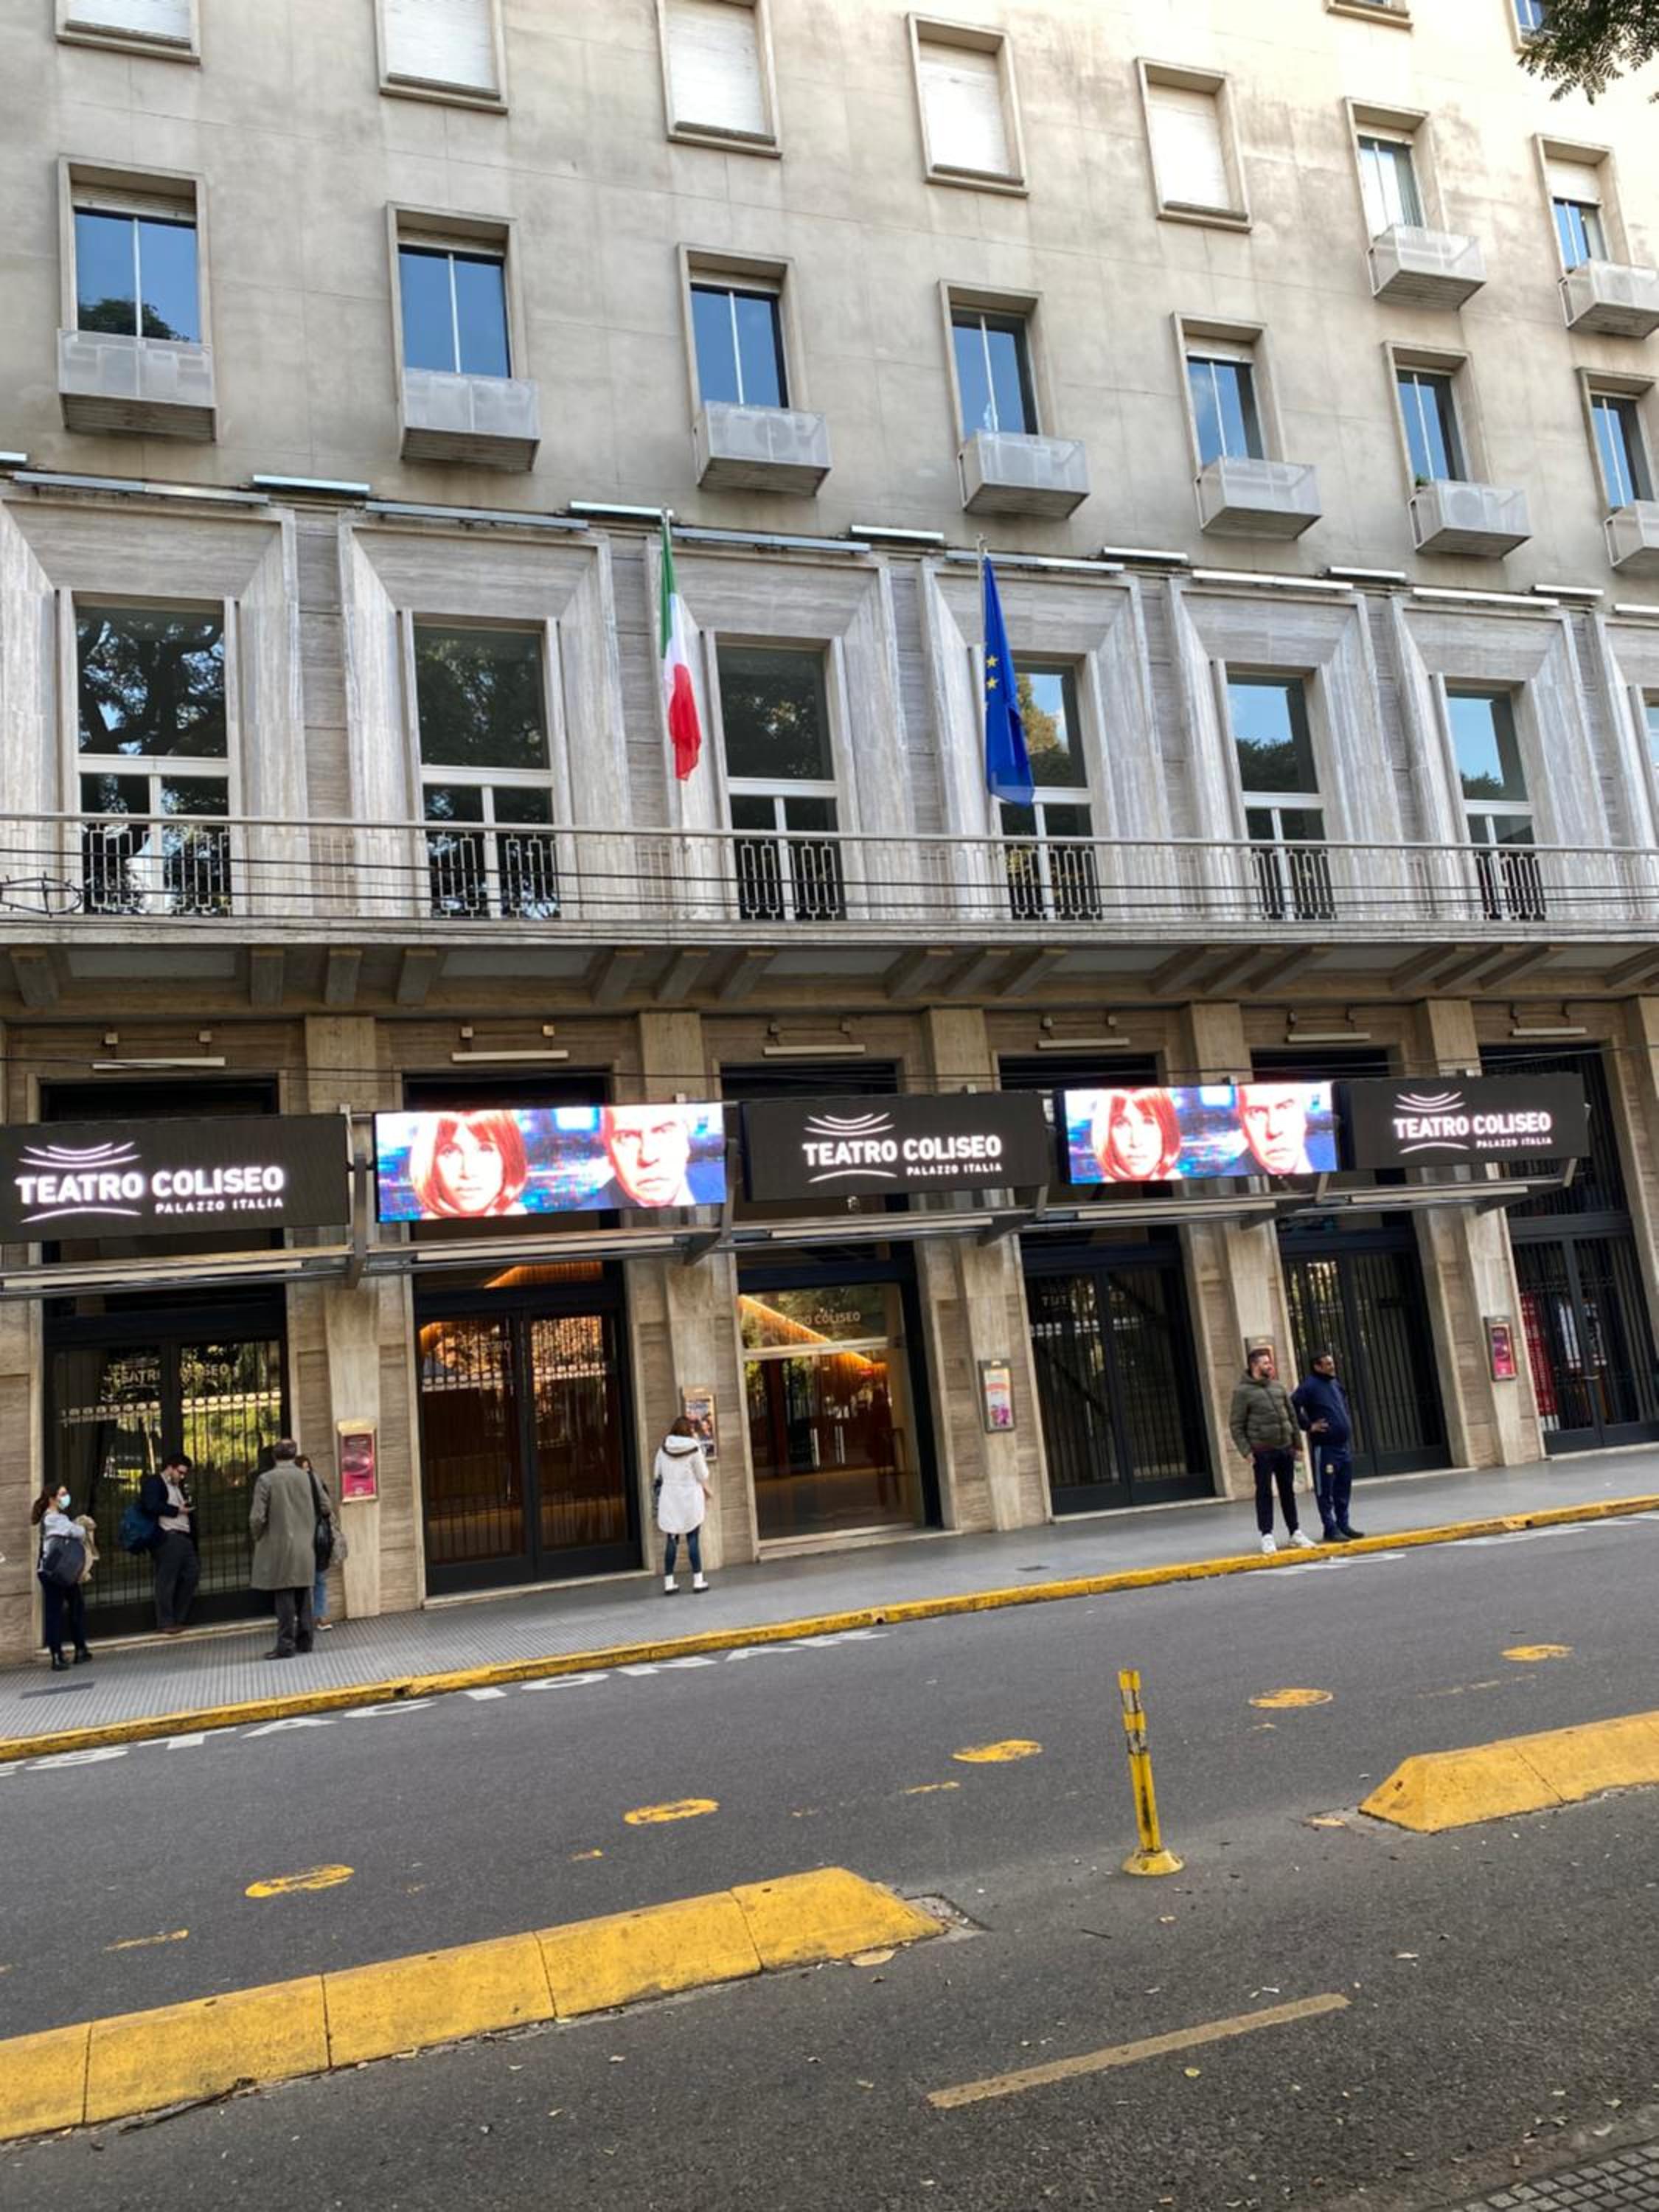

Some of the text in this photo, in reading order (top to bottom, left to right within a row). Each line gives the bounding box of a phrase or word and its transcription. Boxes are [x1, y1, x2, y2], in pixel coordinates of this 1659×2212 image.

[1393, 1111, 1551, 1139] TEATRO COLISEO
[802, 1135, 1002, 1166] TEATRO COLISEO
[1476, 1135, 1552, 1149] PALAZZO ITALIA
[906, 1161, 1002, 1177] PALAZZO ITALIA
[15, 1166, 285, 1204] TEATRO COLISEO
[155, 1197, 284, 1215] PALAZZO ITALIA
